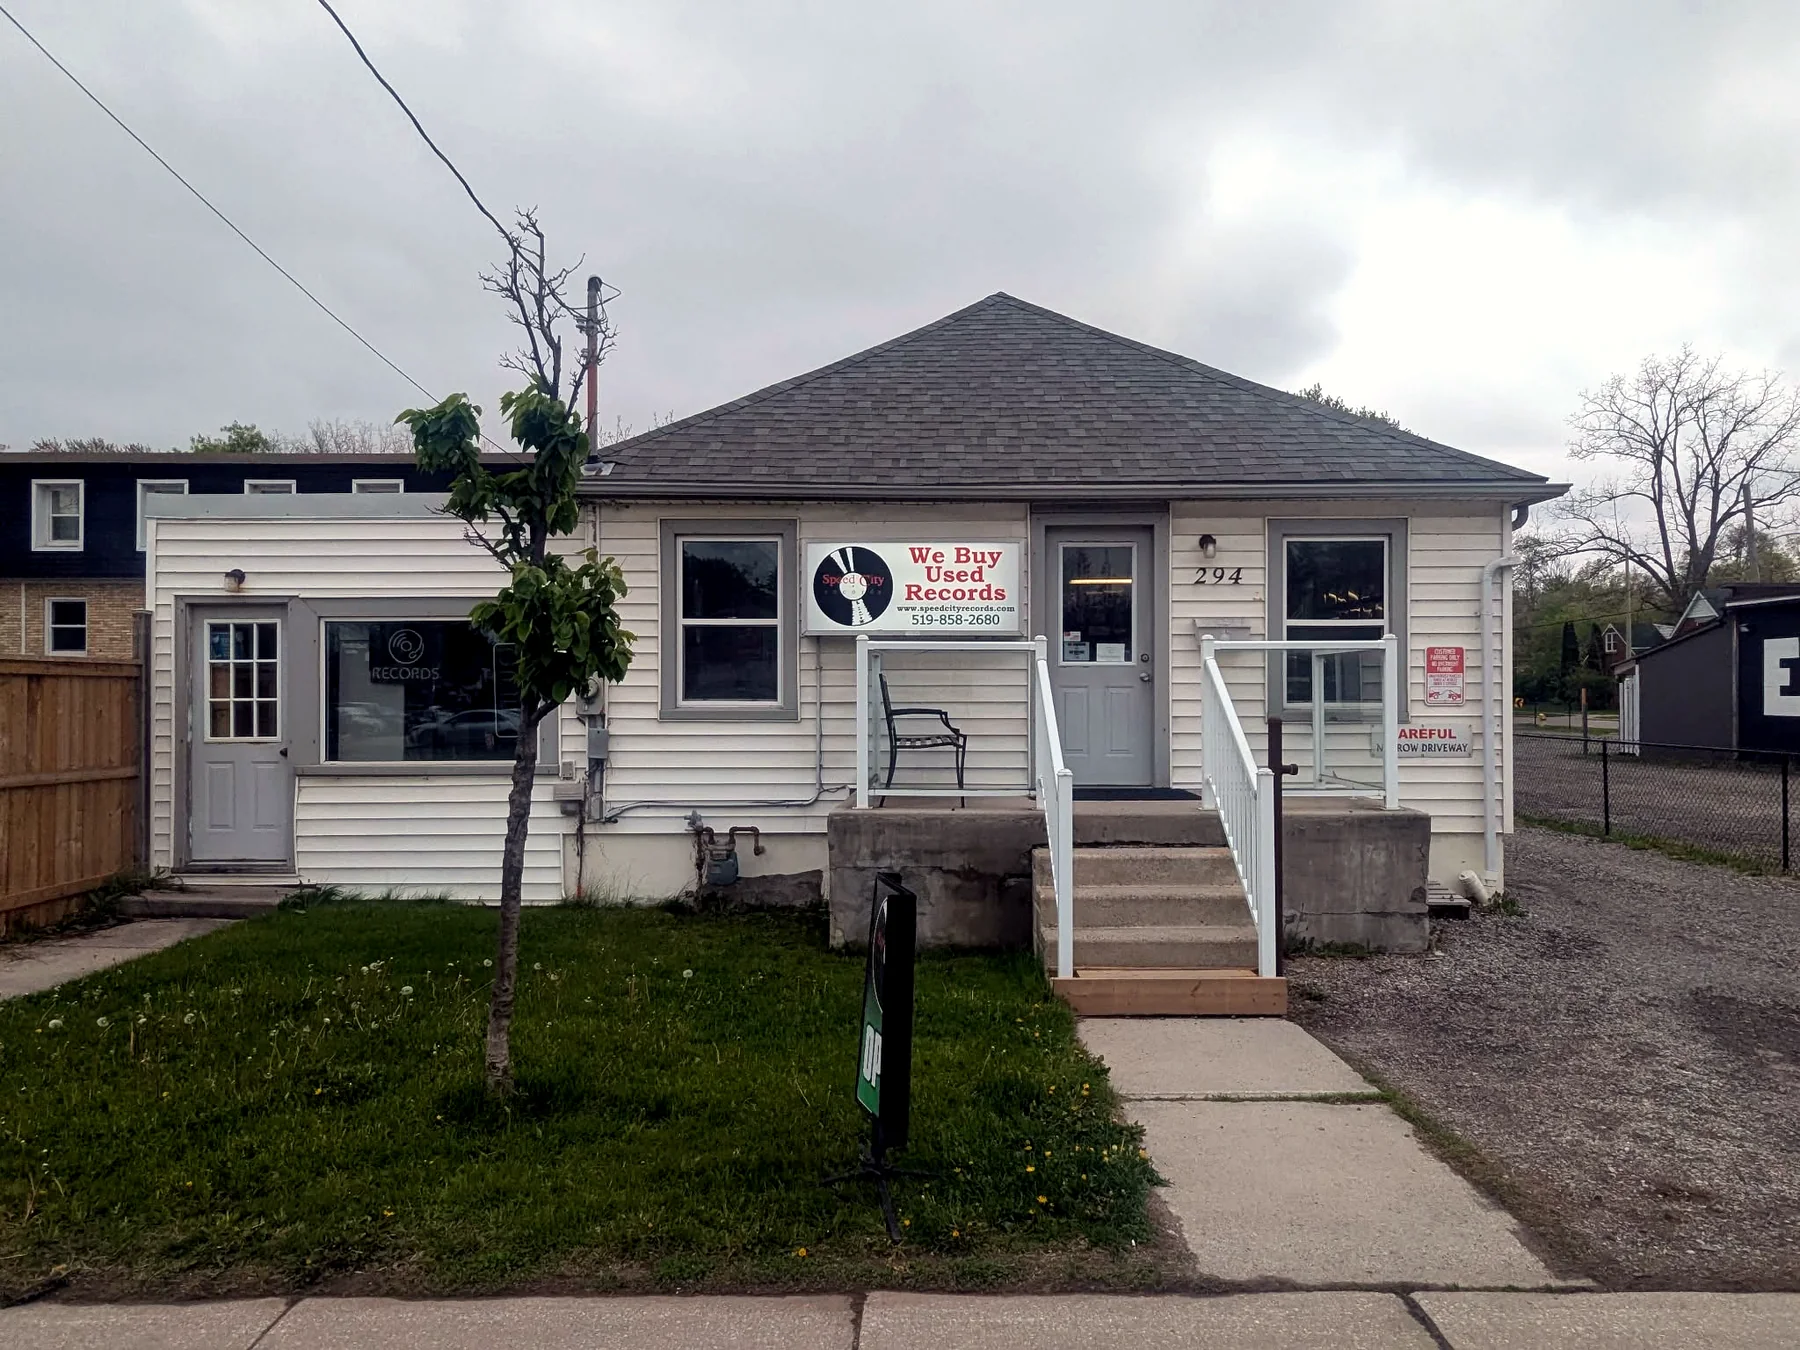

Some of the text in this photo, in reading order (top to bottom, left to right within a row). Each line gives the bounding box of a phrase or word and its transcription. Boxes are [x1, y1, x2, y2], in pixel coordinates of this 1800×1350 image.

[909, 547, 1003, 569] We Buy
[822, 573, 885, 587] Speed City
[925, 565, 985, 583] Used
[1193, 567, 1242, 585] 294
[905, 584, 1007, 601] Records
[896, 605, 1015, 613] www.speedcityrecords.com
[911, 614, 1000, 626] 519-858-2680
[371, 667, 440, 680] RECORDS
[1398, 728, 1457, 739] AREFUL
[1376, 743, 1468, 753] NROW DRIVEWAY
